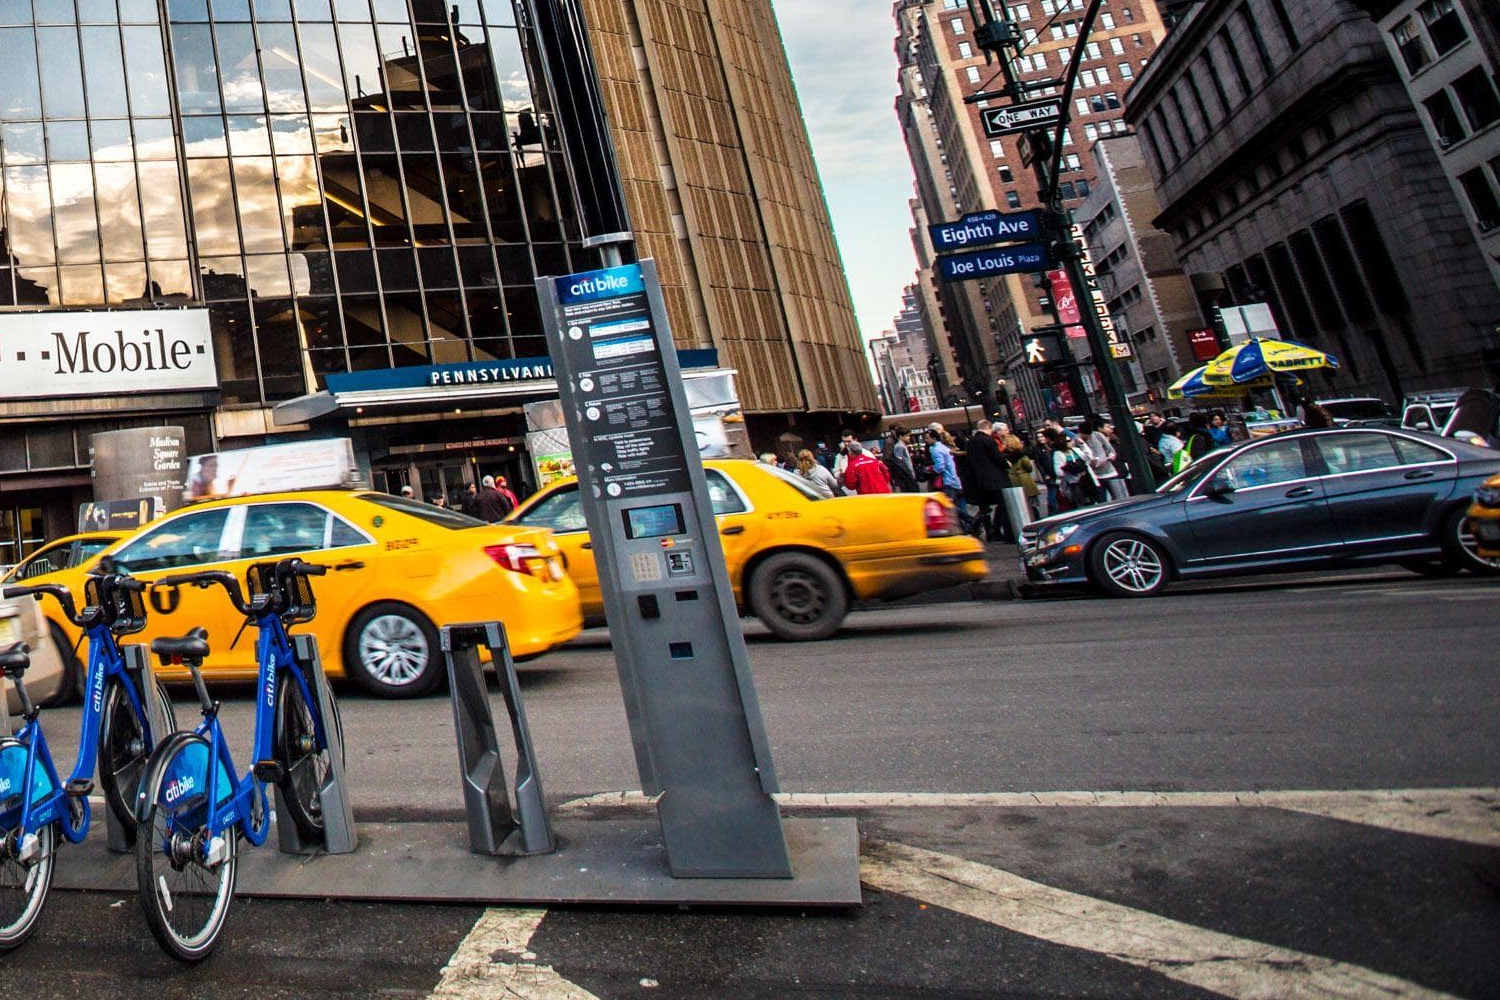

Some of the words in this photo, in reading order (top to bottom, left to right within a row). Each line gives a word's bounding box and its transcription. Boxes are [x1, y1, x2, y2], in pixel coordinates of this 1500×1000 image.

[999, 112, 1020, 124] ONE
[1029, 106, 1052, 118] WAY
[941, 223, 993, 244] Eighth
[998, 220, 1029, 235] Ave
[951, 261, 975, 274] Joe
[976, 254, 1015, 270] Louis
[1018, 254, 1040, 264] Plaza
[1269, 356, 1322, 368] SABRETT
[431, 363, 552, 385] PENNSYLVANI
[149, 436, 180, 448] Madison
[153, 448, 179, 460] Square
[154, 459, 181, 470] Garden
